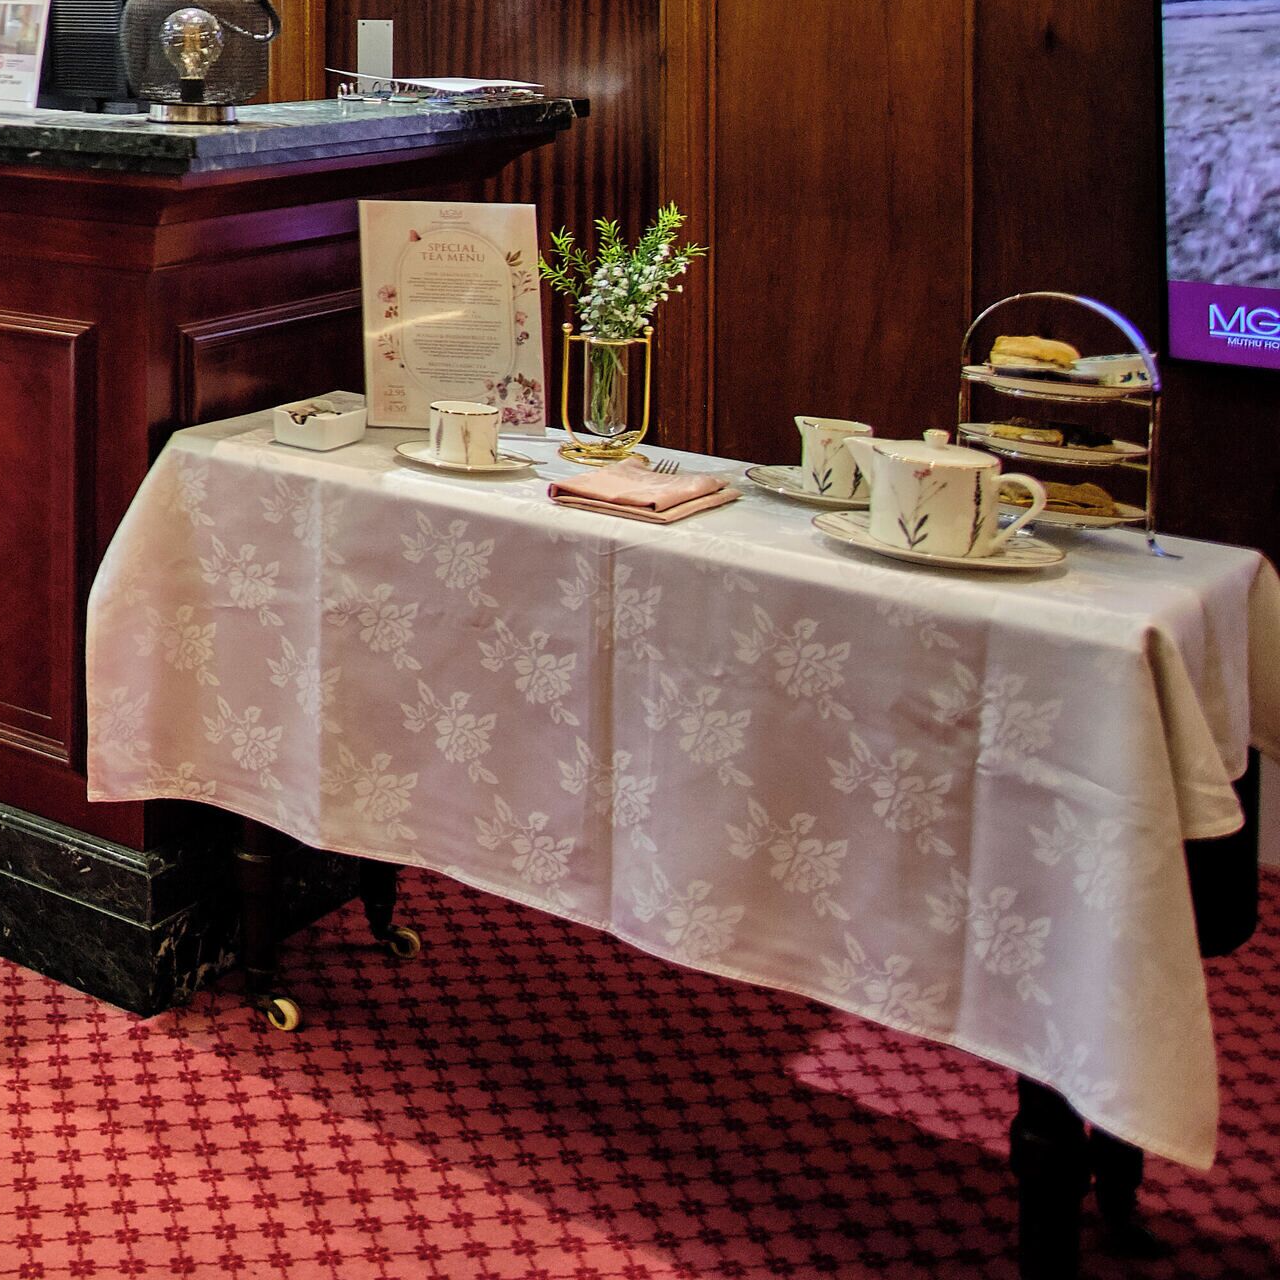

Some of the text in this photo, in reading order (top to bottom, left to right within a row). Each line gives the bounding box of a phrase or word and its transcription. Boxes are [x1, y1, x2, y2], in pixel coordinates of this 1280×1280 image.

[427, 243, 475, 253] SPECIAL
[421, 251, 486, 263] TEA MENU
[1227, 337, 1263, 348] MUTHU
